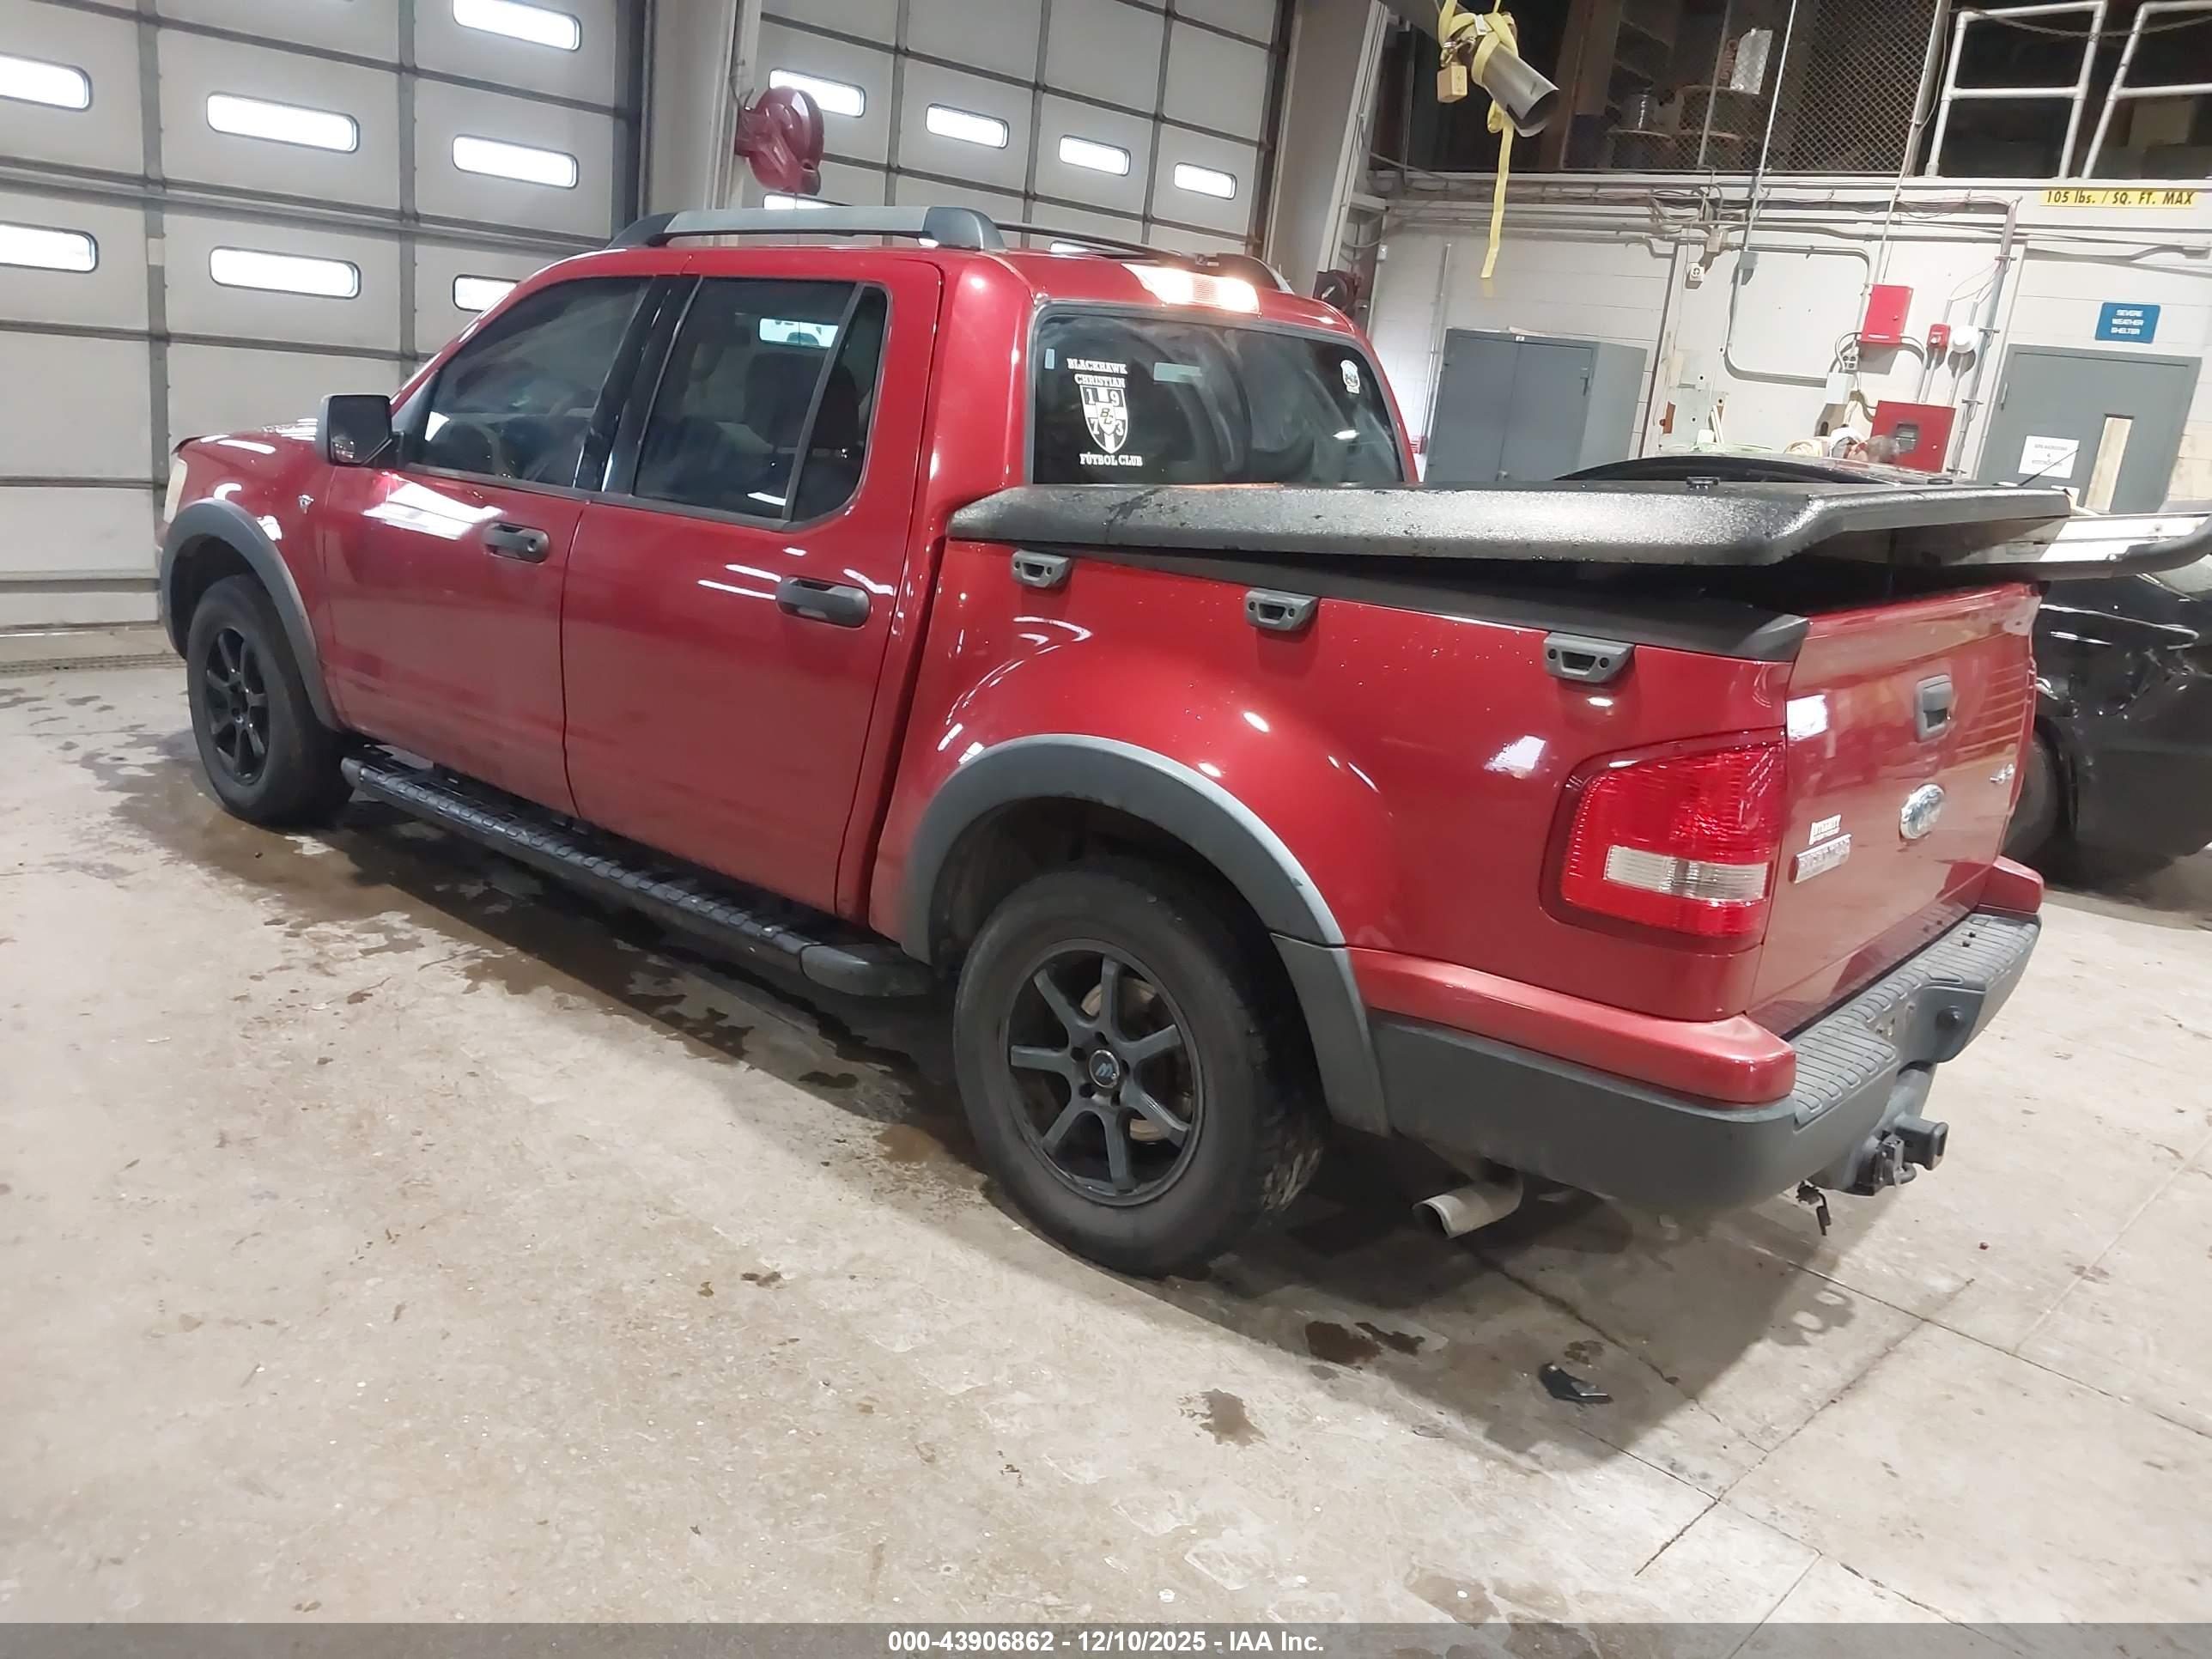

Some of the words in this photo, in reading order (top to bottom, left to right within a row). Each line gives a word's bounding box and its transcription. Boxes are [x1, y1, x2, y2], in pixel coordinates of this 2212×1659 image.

[2047, 191, 2069, 203] 105
[2074, 191, 2095, 204] lbs.
[2112, 191, 2131, 204] SQ.
[2138, 191, 2155, 204] FT.
[2162, 191, 2194, 205] MAX
[1066, 358, 1127, 374] BLACKHAWK
[1074, 374, 1126, 388] CHRISTIAN
[1118, 455, 1143, 466] CLUB
